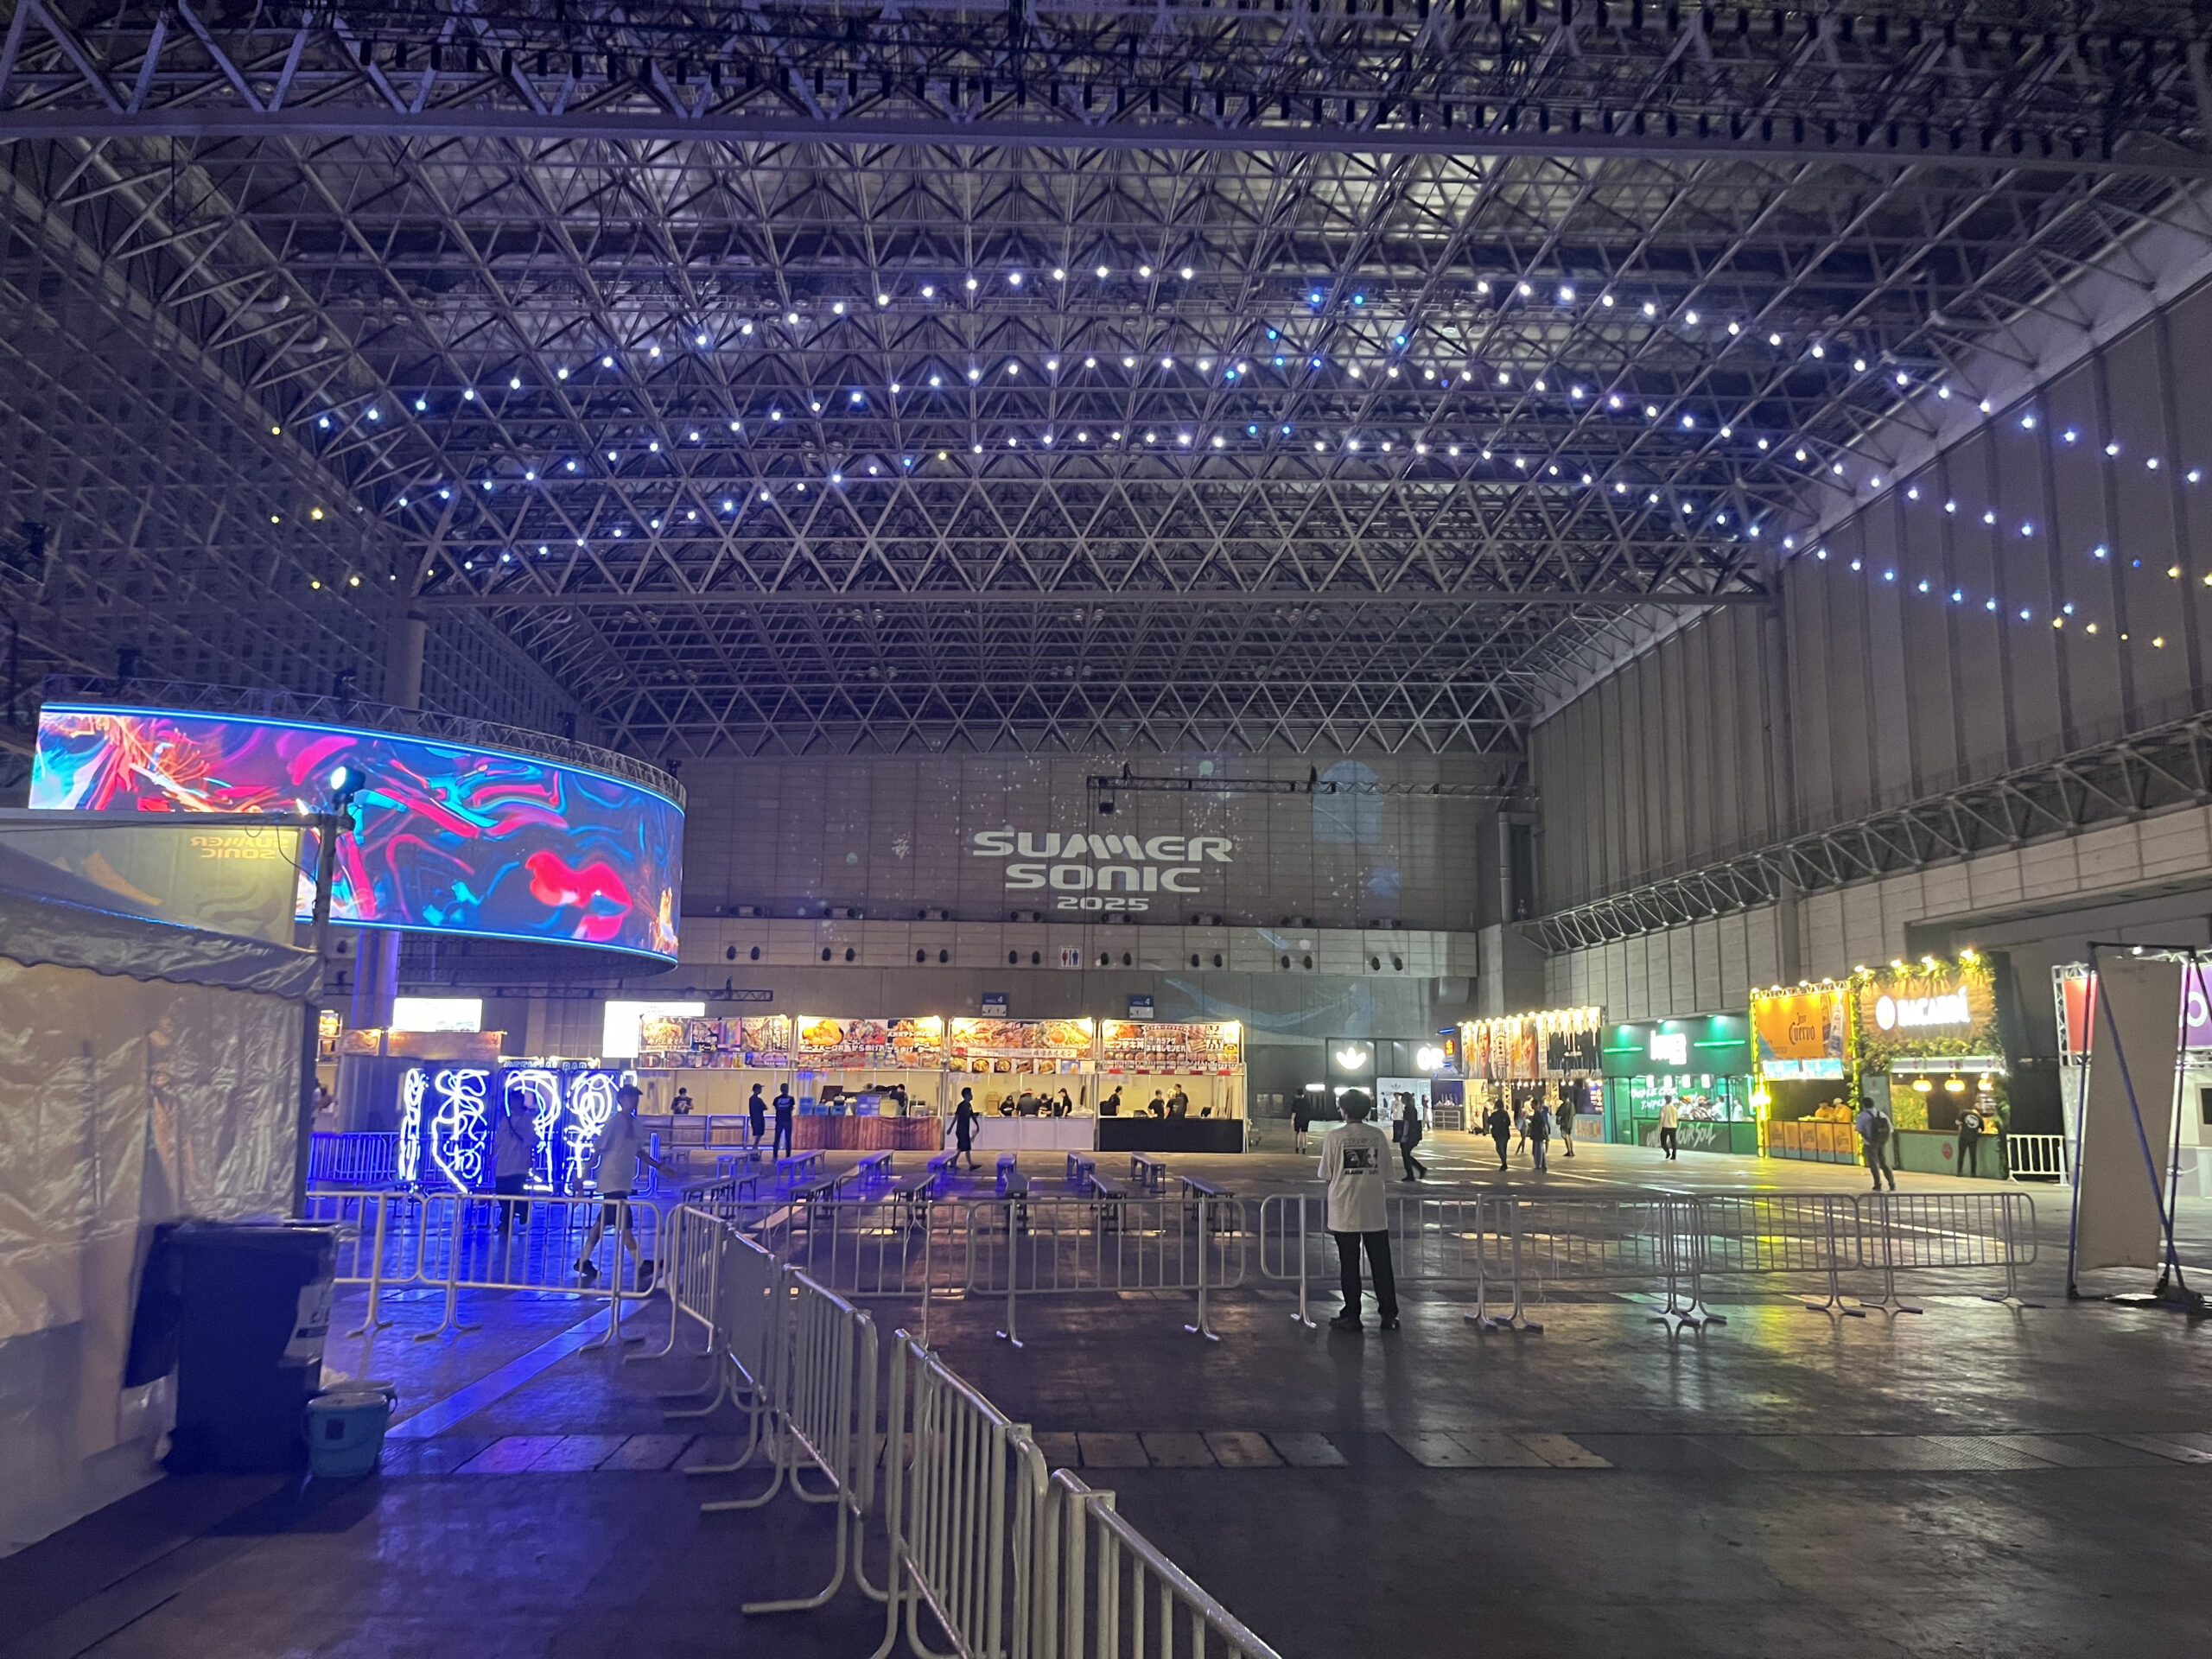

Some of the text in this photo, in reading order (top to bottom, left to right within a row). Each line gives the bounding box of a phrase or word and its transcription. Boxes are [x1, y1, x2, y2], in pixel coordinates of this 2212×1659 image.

[973, 831, 1234, 862] SUMMER
[1005, 863, 1201, 893] SONIC
[1057, 896, 1150, 912] 2025
[1789, 1021, 1815, 1046] Cuervo
